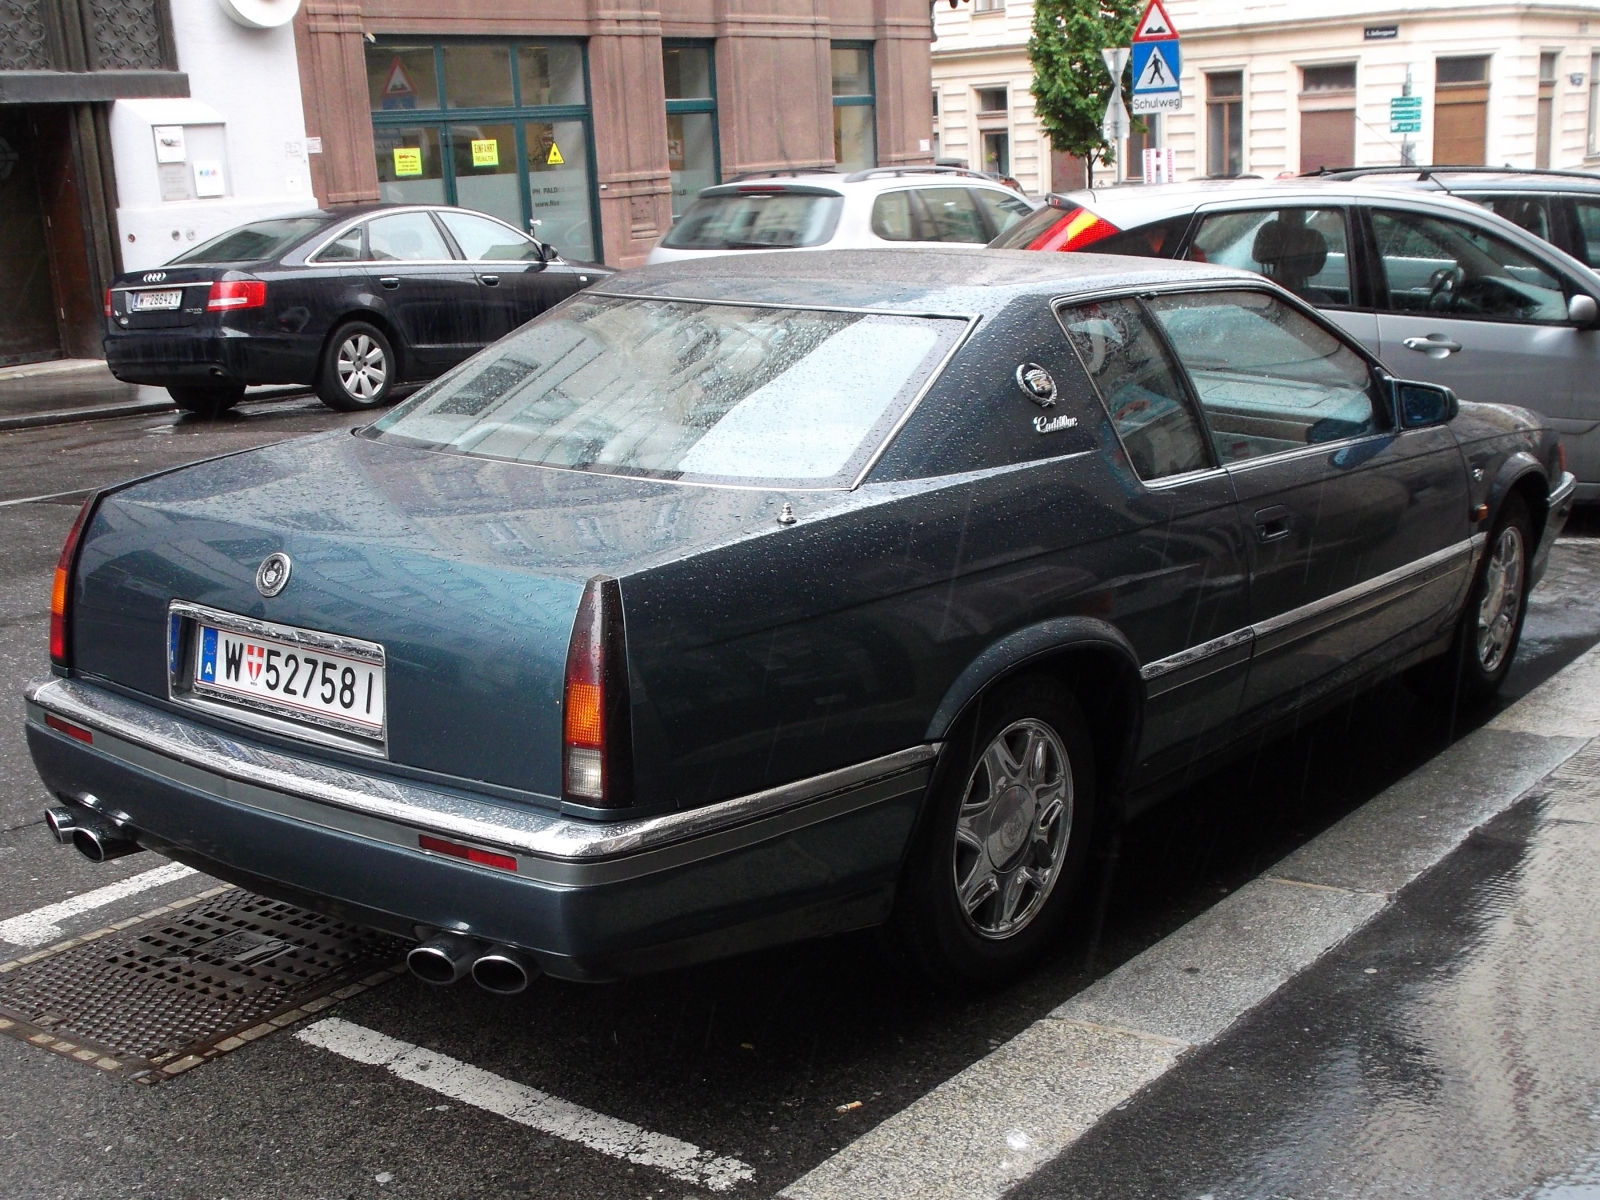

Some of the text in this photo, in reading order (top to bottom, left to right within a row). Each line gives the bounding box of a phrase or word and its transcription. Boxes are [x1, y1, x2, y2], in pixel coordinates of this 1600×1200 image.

[1133, 97, 1181, 110] Schulweg
[474, 143, 495, 154] EINFAHRT
[139, 295, 145, 306] W
[1033, 414, 1078, 434] Cadillac
[225, 639, 244, 682] W
[204, 663, 213, 675] A
